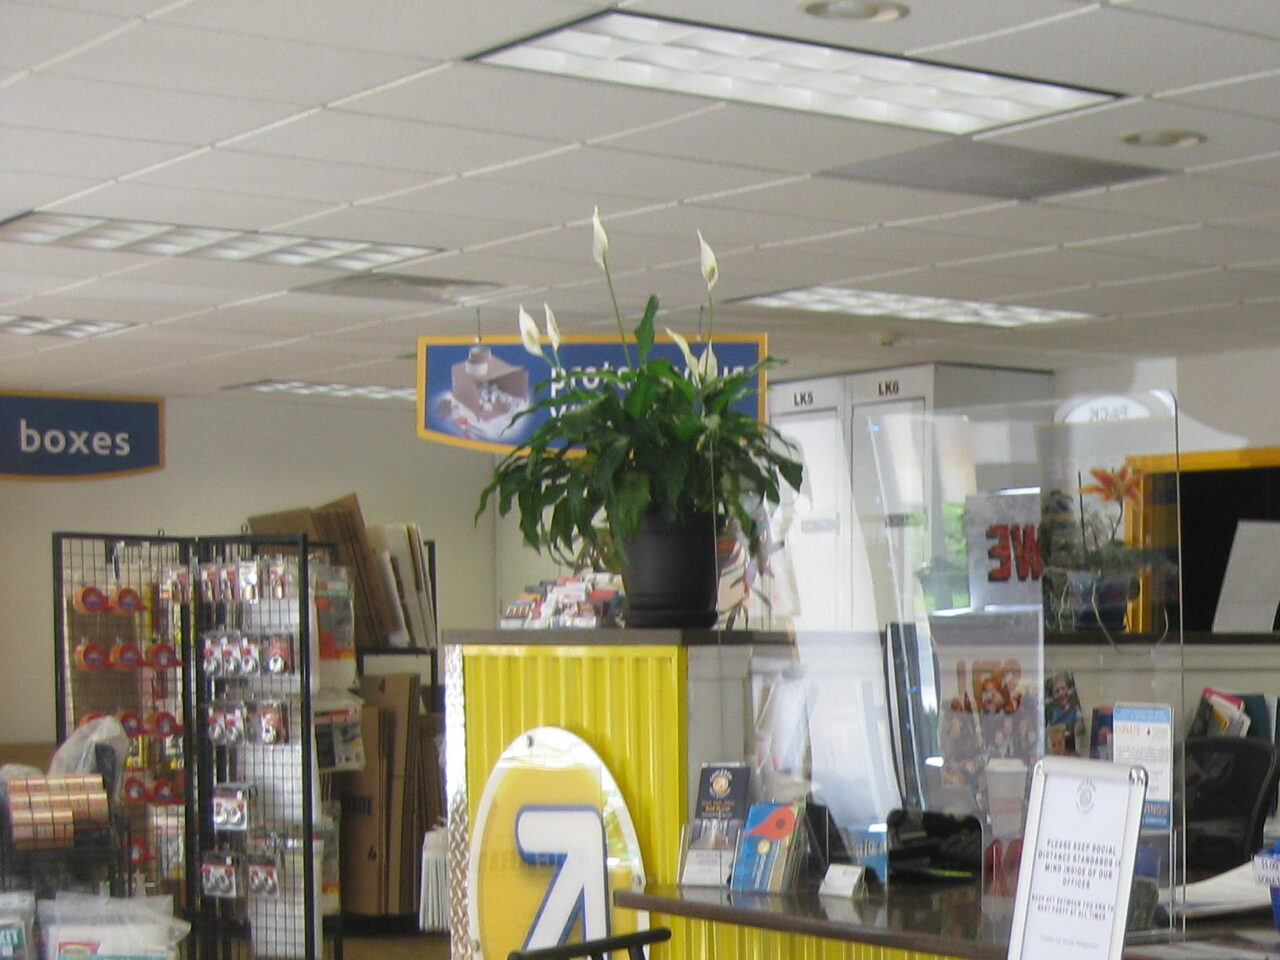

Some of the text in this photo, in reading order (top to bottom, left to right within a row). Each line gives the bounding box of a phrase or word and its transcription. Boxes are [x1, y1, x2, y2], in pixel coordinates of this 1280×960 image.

[794, 390, 814, 406] LK5
[20, 418, 131, 456] boxes
[1046, 838, 1072, 851] PLEASE
[1091, 843, 1117, 856] SOCIAL
[1038, 848, 1071, 862] DISTANCE
[1072, 853, 1113, 868] STANDARDS
[1063, 864, 1086, 877] INSIDE
[1098, 869, 1113, 881] OUR
